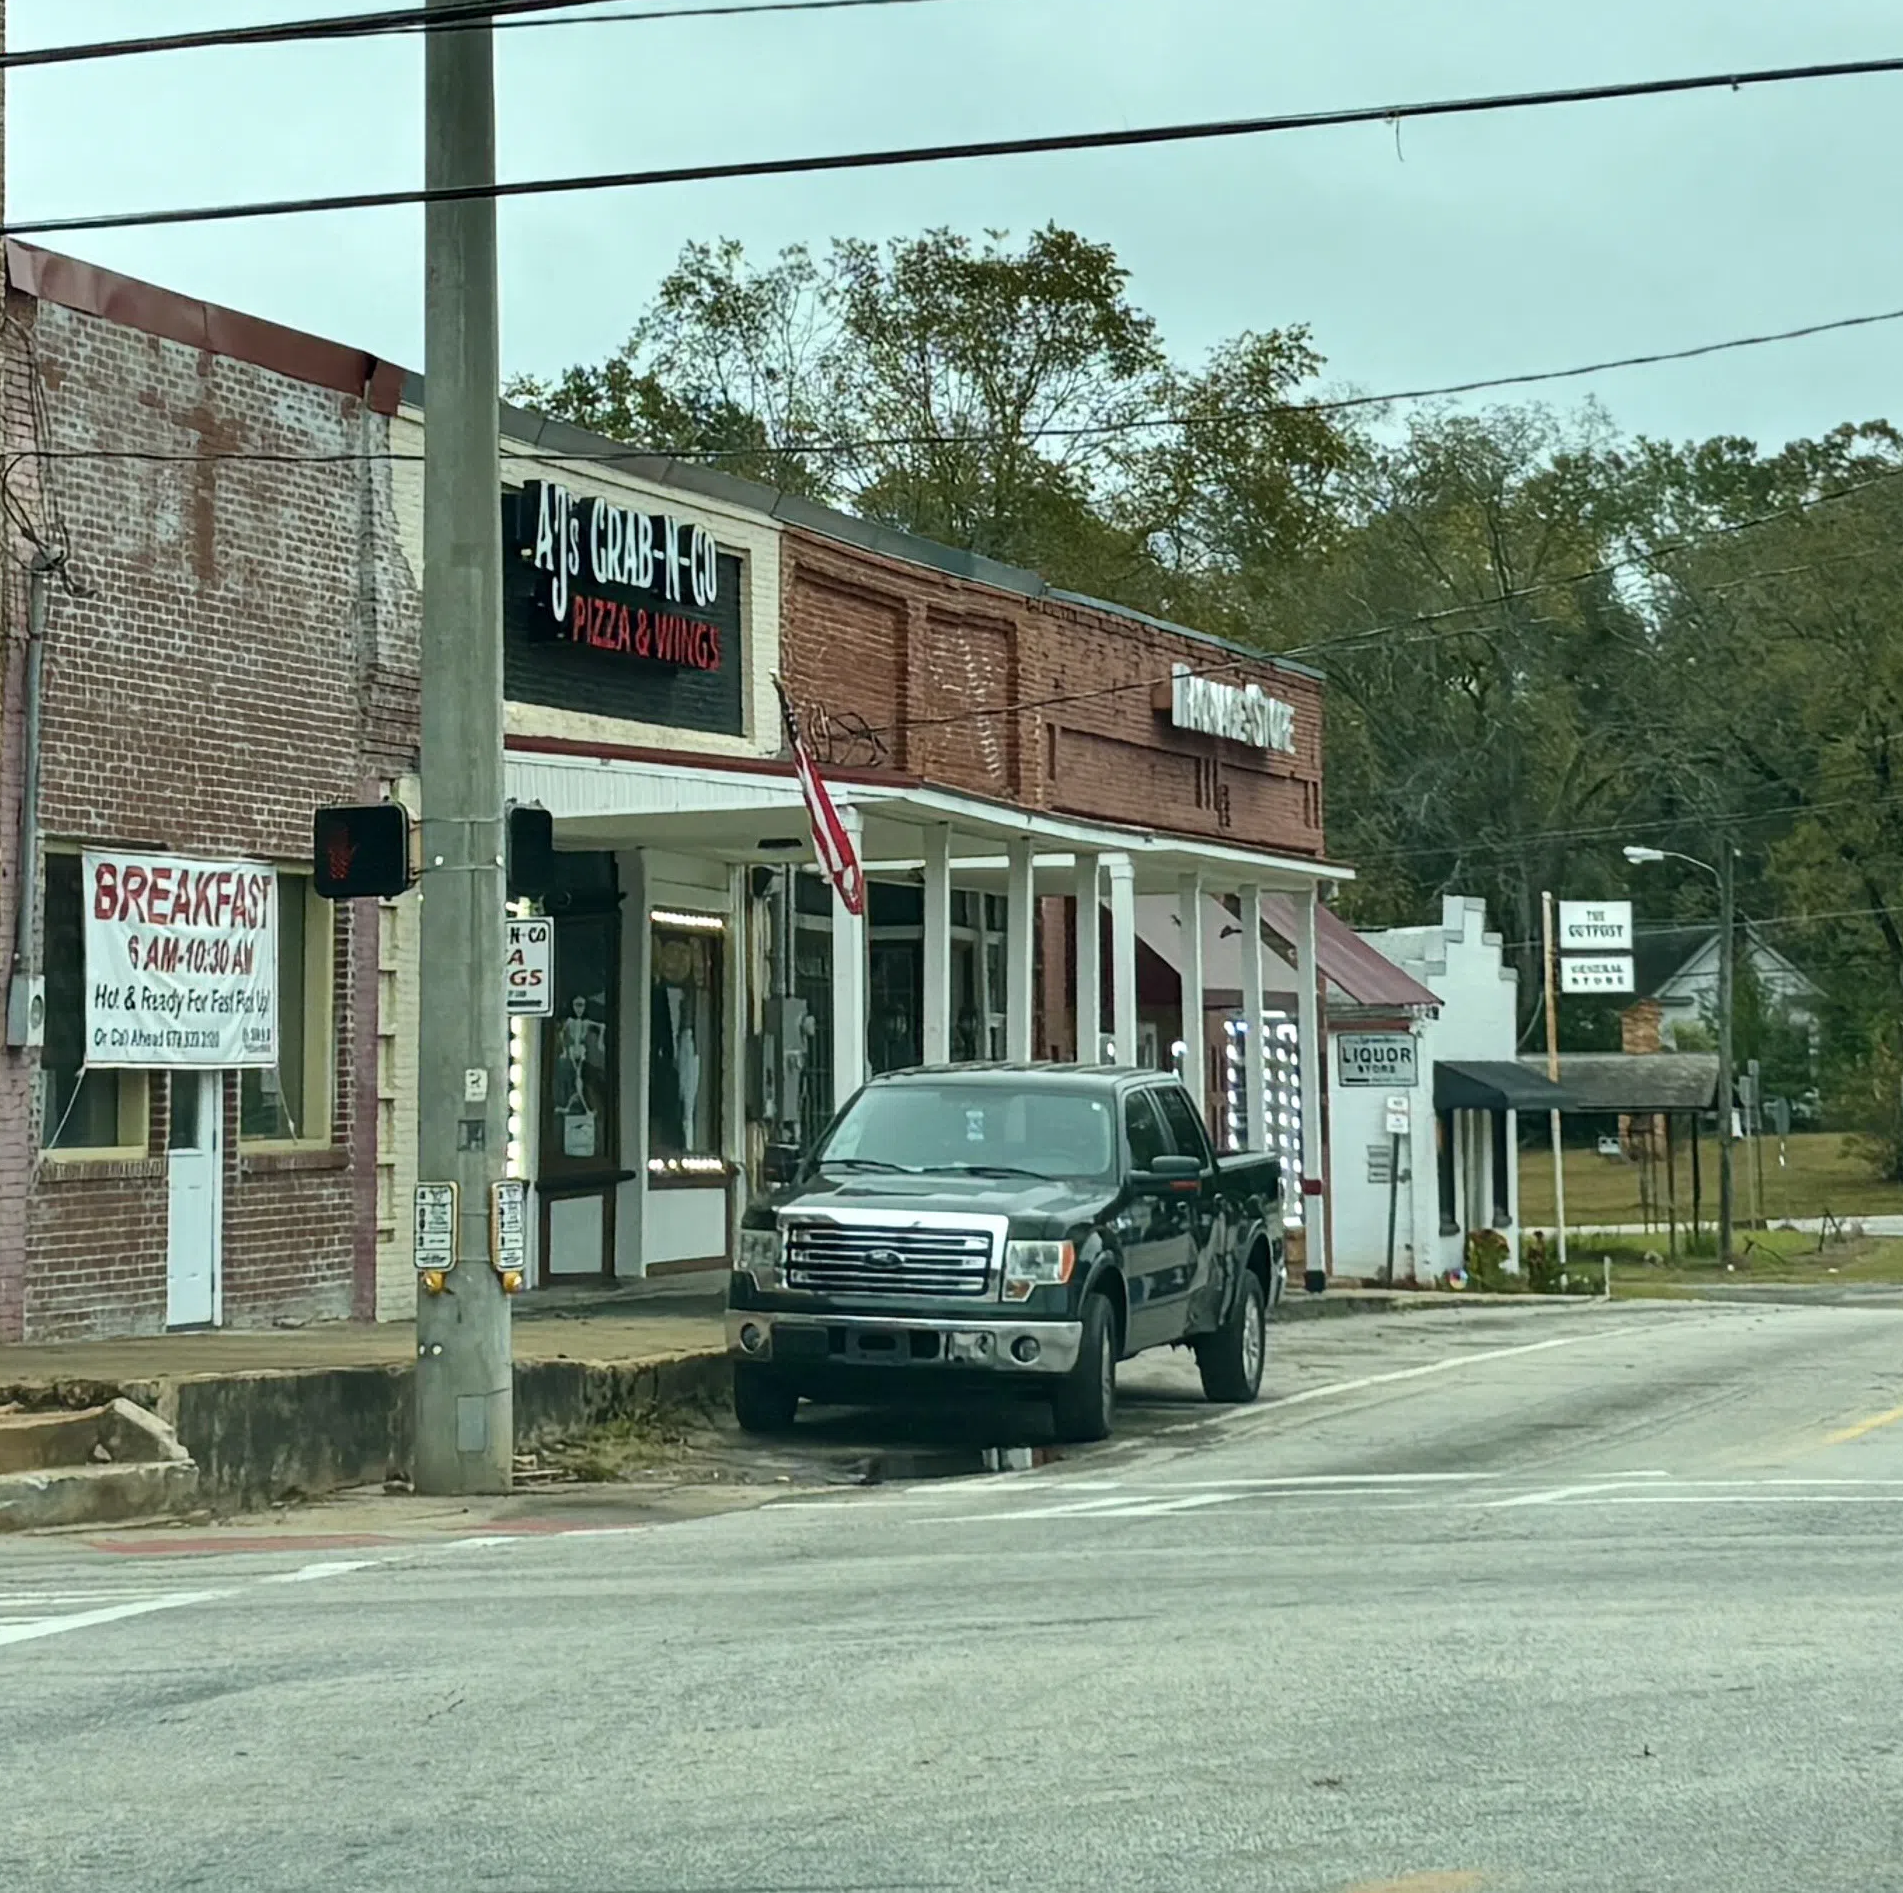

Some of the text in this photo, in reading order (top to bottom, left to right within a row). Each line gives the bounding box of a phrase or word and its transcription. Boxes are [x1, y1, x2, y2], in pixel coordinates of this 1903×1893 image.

[573, 596, 721, 671] PIZZA & WINGS
[94, 863, 273, 929] BREAKFAST
[128, 935, 139, 971] 6
[124, 985, 135, 1010] &
[141, 985, 184, 1019] Ready
[187, 989, 209, 1012] For
[1342, 1047, 1412, 1063] LIQUOR
[1358, 1064, 1396, 1074] STORE
